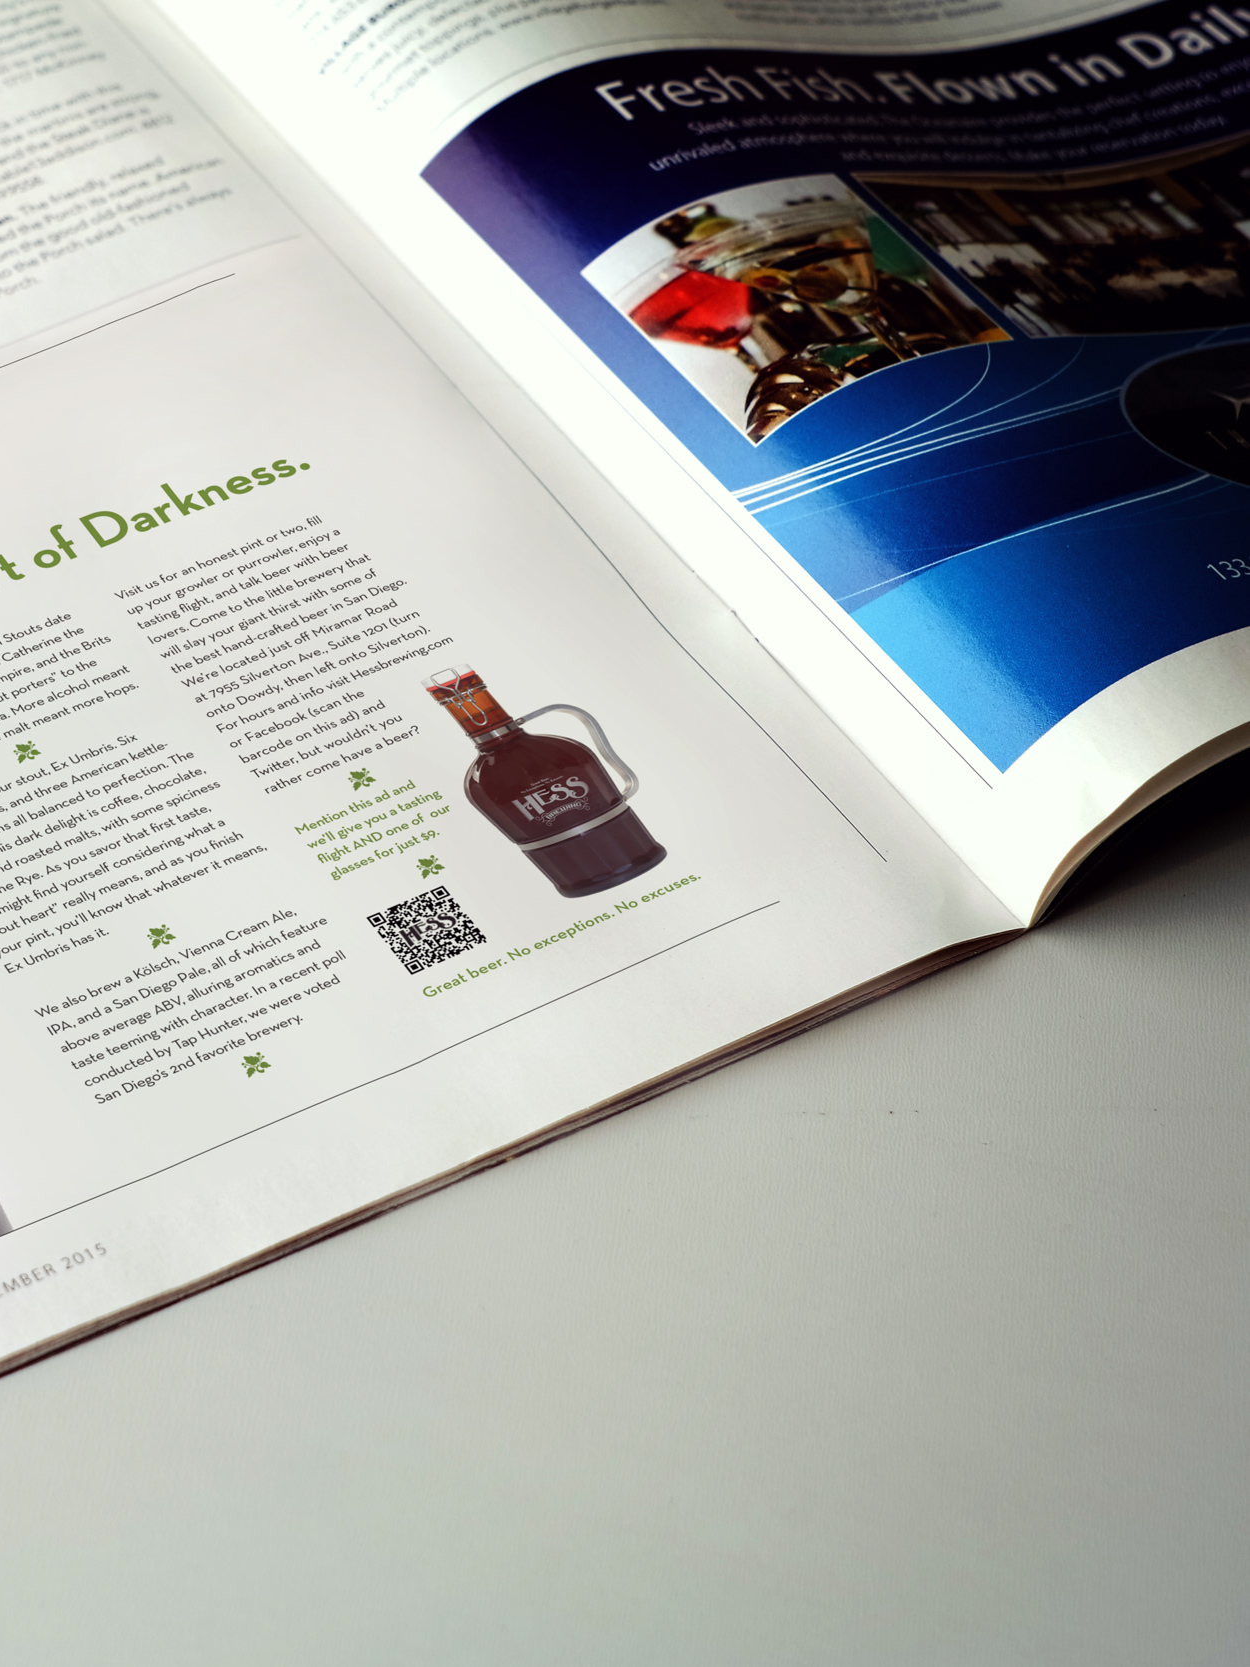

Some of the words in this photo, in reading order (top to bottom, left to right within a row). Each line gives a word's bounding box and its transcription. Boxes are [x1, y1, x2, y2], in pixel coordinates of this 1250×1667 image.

[594, 64, 765, 121] Fresh
[764, 68, 887, 108] Fish.
[877, 67, 1060, 108] Flown
[1047, 53, 1127, 88] in
[647, 137, 738, 174] unrivaled
[33, 523, 78, 568] of
[78, 459, 310, 548] Darkness.
[2, 624, 43, 642] Stouts
[44, 613, 71, 627] date
[194, 692, 208, 703] at
[208, 680, 240, 698] 7955
[239, 659, 296, 684] Silverton
[298, 649, 328, 662] Ave.,
[327, 634, 361, 650] Suite
[361, 622, 388, 636] 1201
[388, 611, 420, 627] (turn
[215, 720, 238, 733] For
[238, 706, 275, 724] hours
[276, 693, 300, 710] and
[298, 686, 324, 700] info
[325, 675, 351, 689] visit
[349, 636, 454, 680] Hessbrewing.com
[15, 767, 51, 786] stout,
[50, 761, 69, 771] Ex
[68, 743, 117, 764] Umbris.
[116, 734, 138, 746] Six
[14, 840, 62, 866] roasted
[64, 830, 101, 847] malts,
[100, 816, 129, 831] with
[130, 804, 164, 821] some
[165, 781, 220, 807] spiciness
[294, 810, 349, 834] Mention
[348, 799, 373, 812] this
[374, 789, 391, 803] ad
[392, 779, 416, 795] and
[337, 823, 363, 839] give
[363, 812, 388, 828] you
[397, 790, 443, 811] tasting
[511, 776, 590, 822] HESS
[545, 800, 583, 820] BREWING
[317, 844, 352, 863] flight
[353, 831, 383, 850] AND
[385, 823, 409, 836] one
[411, 812, 424, 825] of
[429, 805, 450, 817] our
[330, 856, 375, 880] glasses
[373, 847, 394, 859] for
[394, 835, 421, 854] just
[420, 829, 440, 841] $9.
[399, 911, 457, 948] HESS
[422, 973, 468, 997] Great
[465, 958, 507, 979] beer.
[506, 947, 531, 960] No
[533, 912, 615, 949] exceptions.
[613, 900, 638, 913] No
[640, 874, 701, 902] excuses.
[84, 1050, 154, 1086] conducted
[152, 1046, 171, 1058] by
[171, 1036, 197, 1049] Tap
[197, 1016, 247, 1039] Hunter,
[247, 1007, 268, 1018] we
[268, 993, 302, 1009] were
[303, 973, 340, 995] voted
[60, 1242, 107, 1270] 2015
